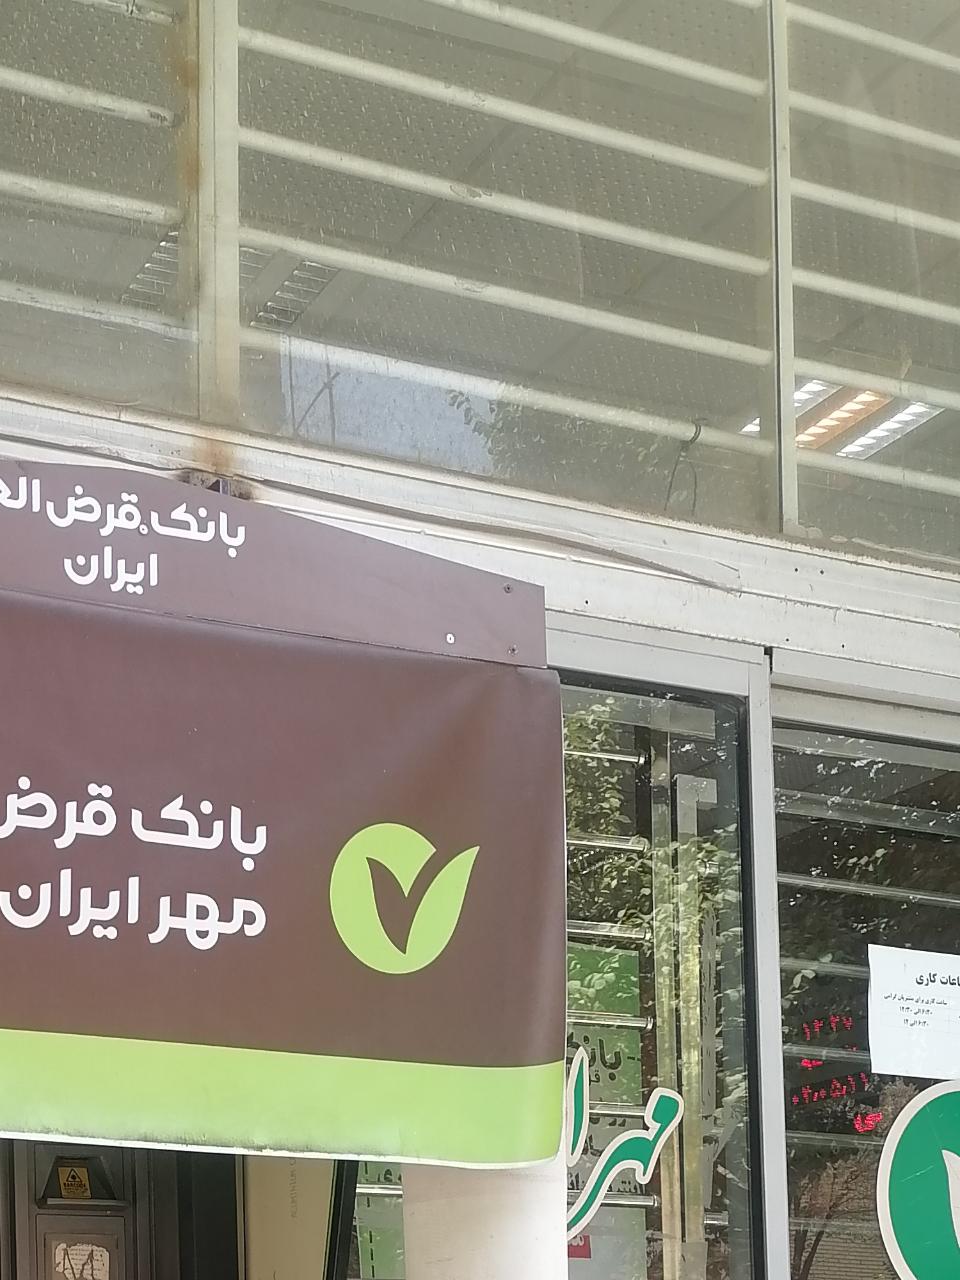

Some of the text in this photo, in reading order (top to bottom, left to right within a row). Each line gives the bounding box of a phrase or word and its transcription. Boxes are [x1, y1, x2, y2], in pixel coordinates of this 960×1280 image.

[45, 485, 141, 537] قرض
[149, 502, 246, 558] بانک
[62, 545, 159, 595] ایران
[131, 794, 267, 871] بانک
[147, 891, 268, 951] مهر
[915, 972, 960, 988] اعات کاری
